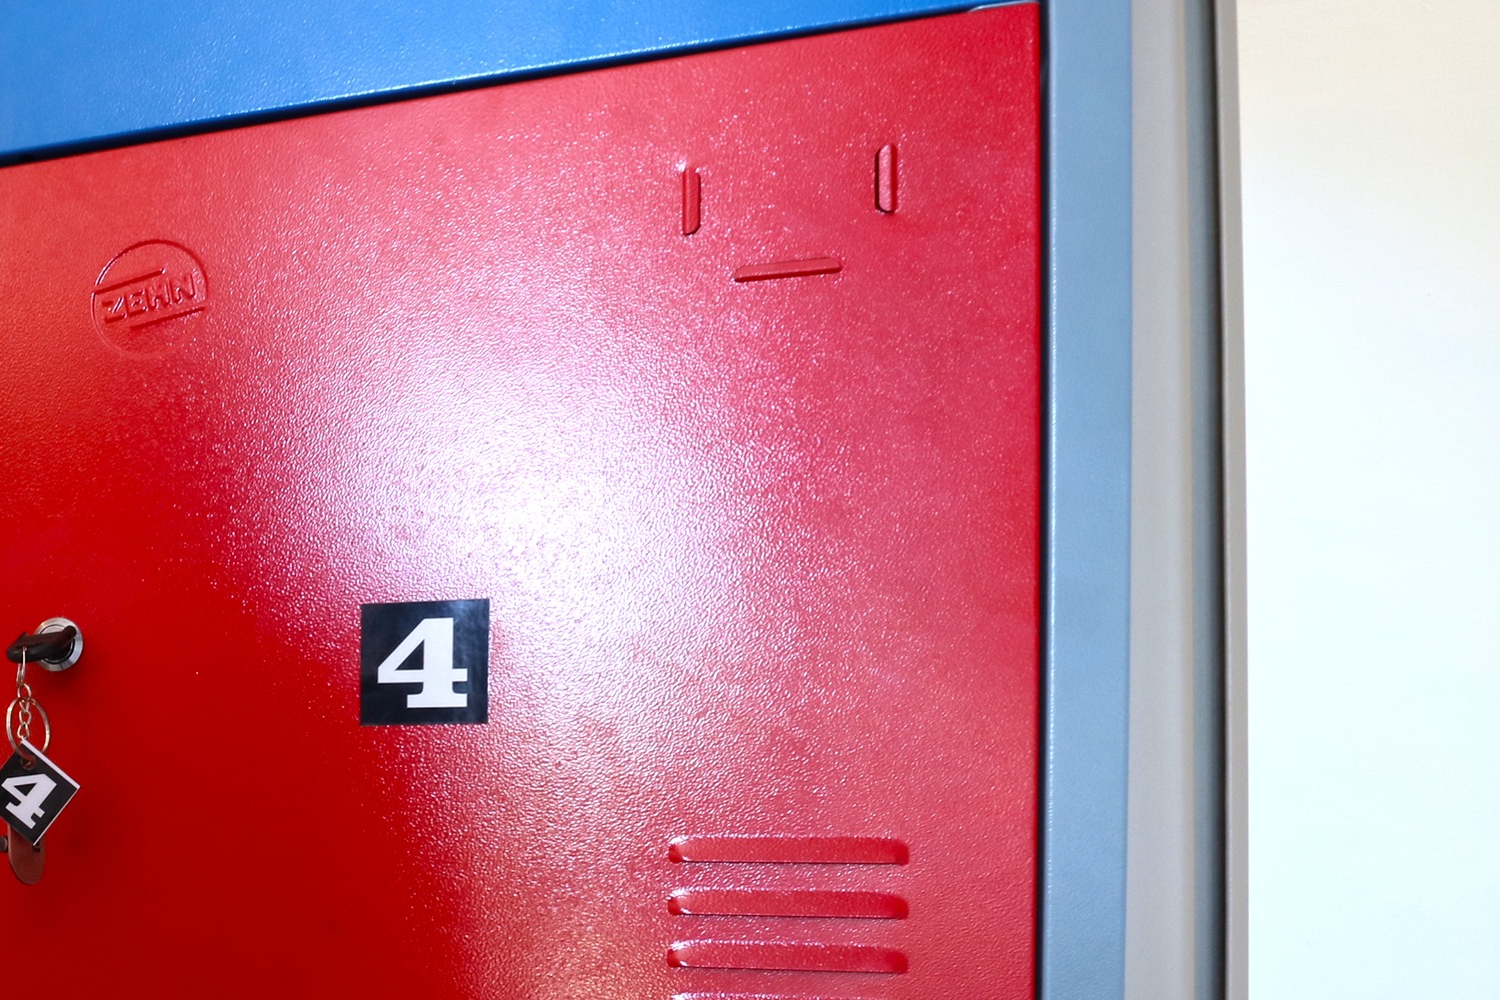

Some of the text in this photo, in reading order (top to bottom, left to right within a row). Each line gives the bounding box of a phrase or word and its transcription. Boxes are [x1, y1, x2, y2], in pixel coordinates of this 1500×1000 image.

[102, 272, 197, 324] ZEHN
[377, 617, 468, 709] 4
[1, 773, 57, 829] 4
